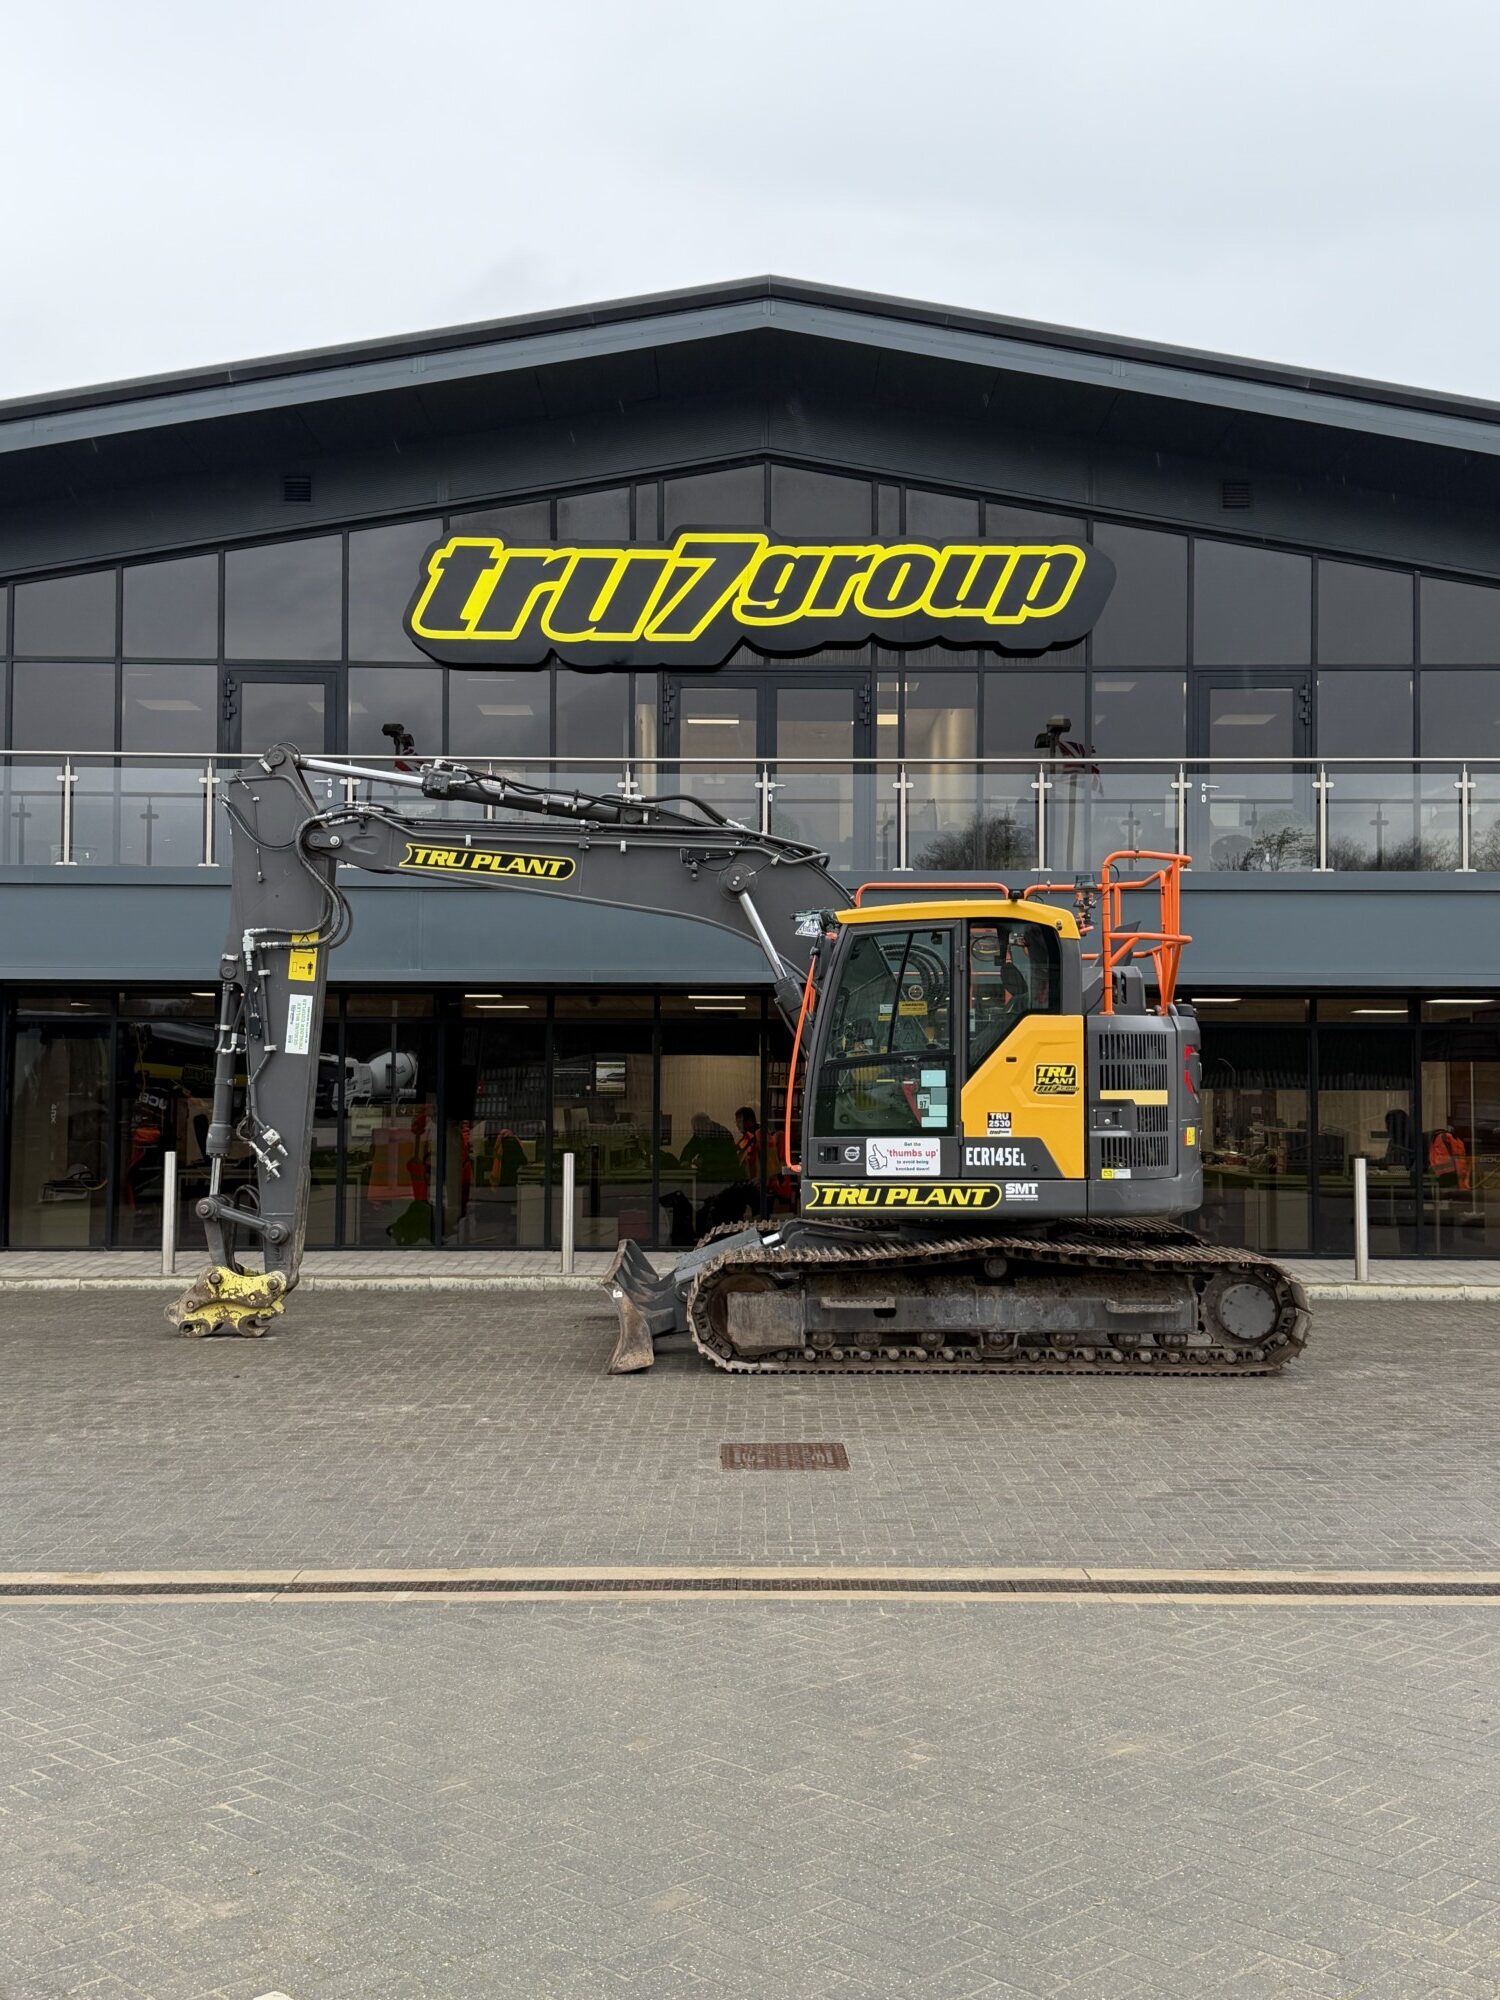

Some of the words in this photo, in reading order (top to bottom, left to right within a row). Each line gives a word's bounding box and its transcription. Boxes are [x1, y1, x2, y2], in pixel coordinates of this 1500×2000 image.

[411, 532, 1088, 643] tru7group
[415, 848, 468, 867] TRU
[470, 854, 565, 876] PLANT
[1037, 1066, 1075, 1077] TRU
[1037, 1077, 1075, 1085] PLANT
[989, 1112, 1009, 1120] TRU
[988, 1120, 1011, 1128] 2530
[1005, 1182, 1039, 1195] SMT
[821, 1187, 881, 1205] TRU
[885, 1187, 991, 1205] PLANT
